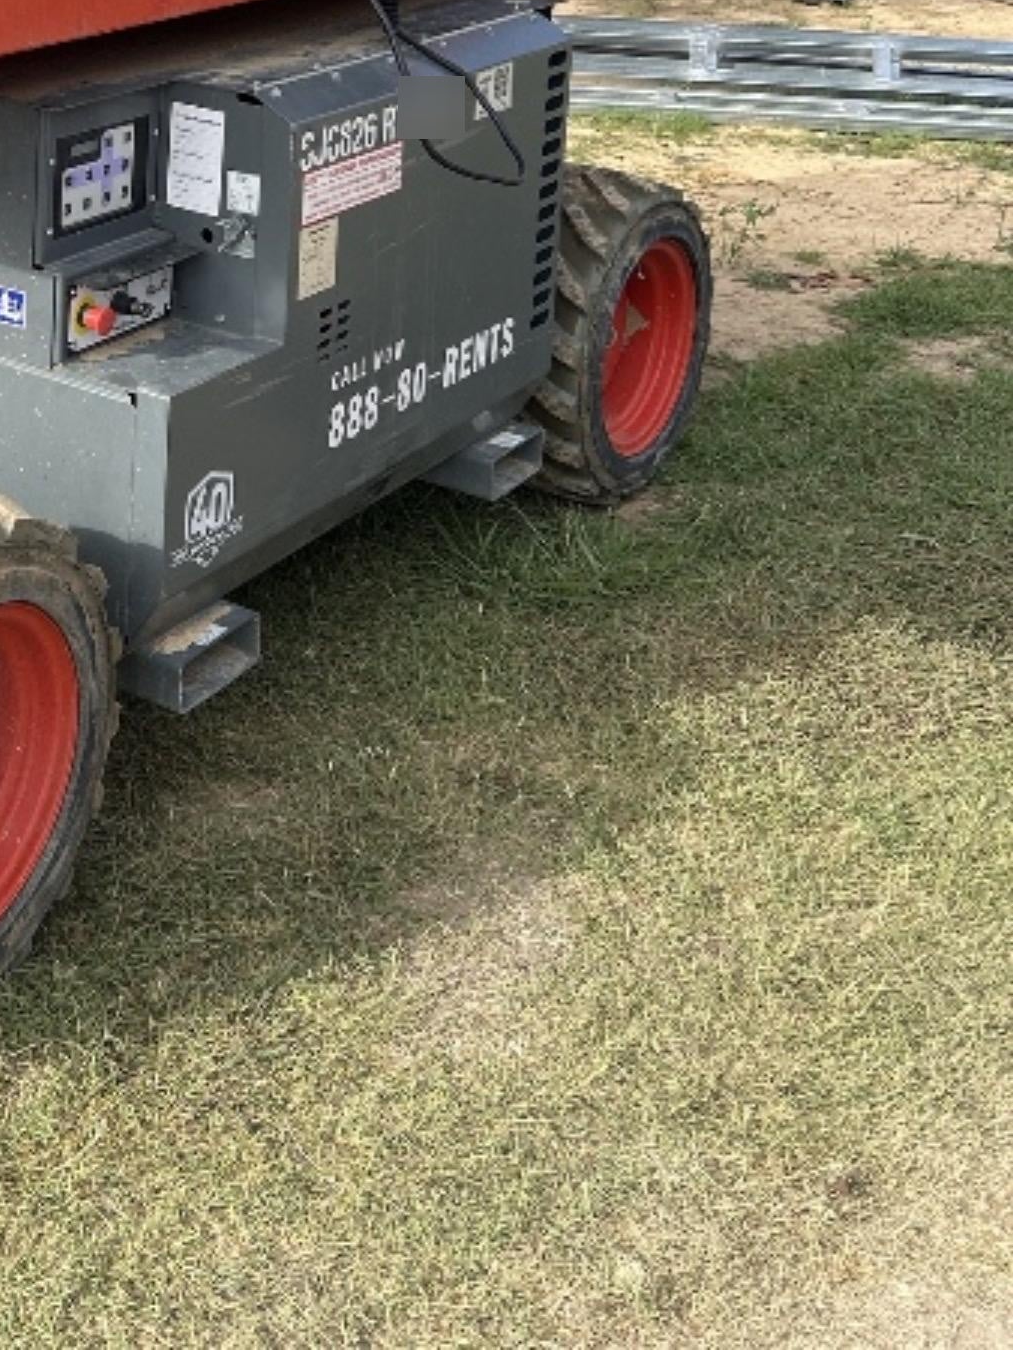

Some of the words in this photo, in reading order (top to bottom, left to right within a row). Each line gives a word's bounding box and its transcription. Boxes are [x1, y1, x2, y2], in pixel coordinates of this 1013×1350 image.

[382, 103, 399, 145] R
[328, 316, 516, 449] 888-80-RENTS
[331, 355, 368, 391] CALL
